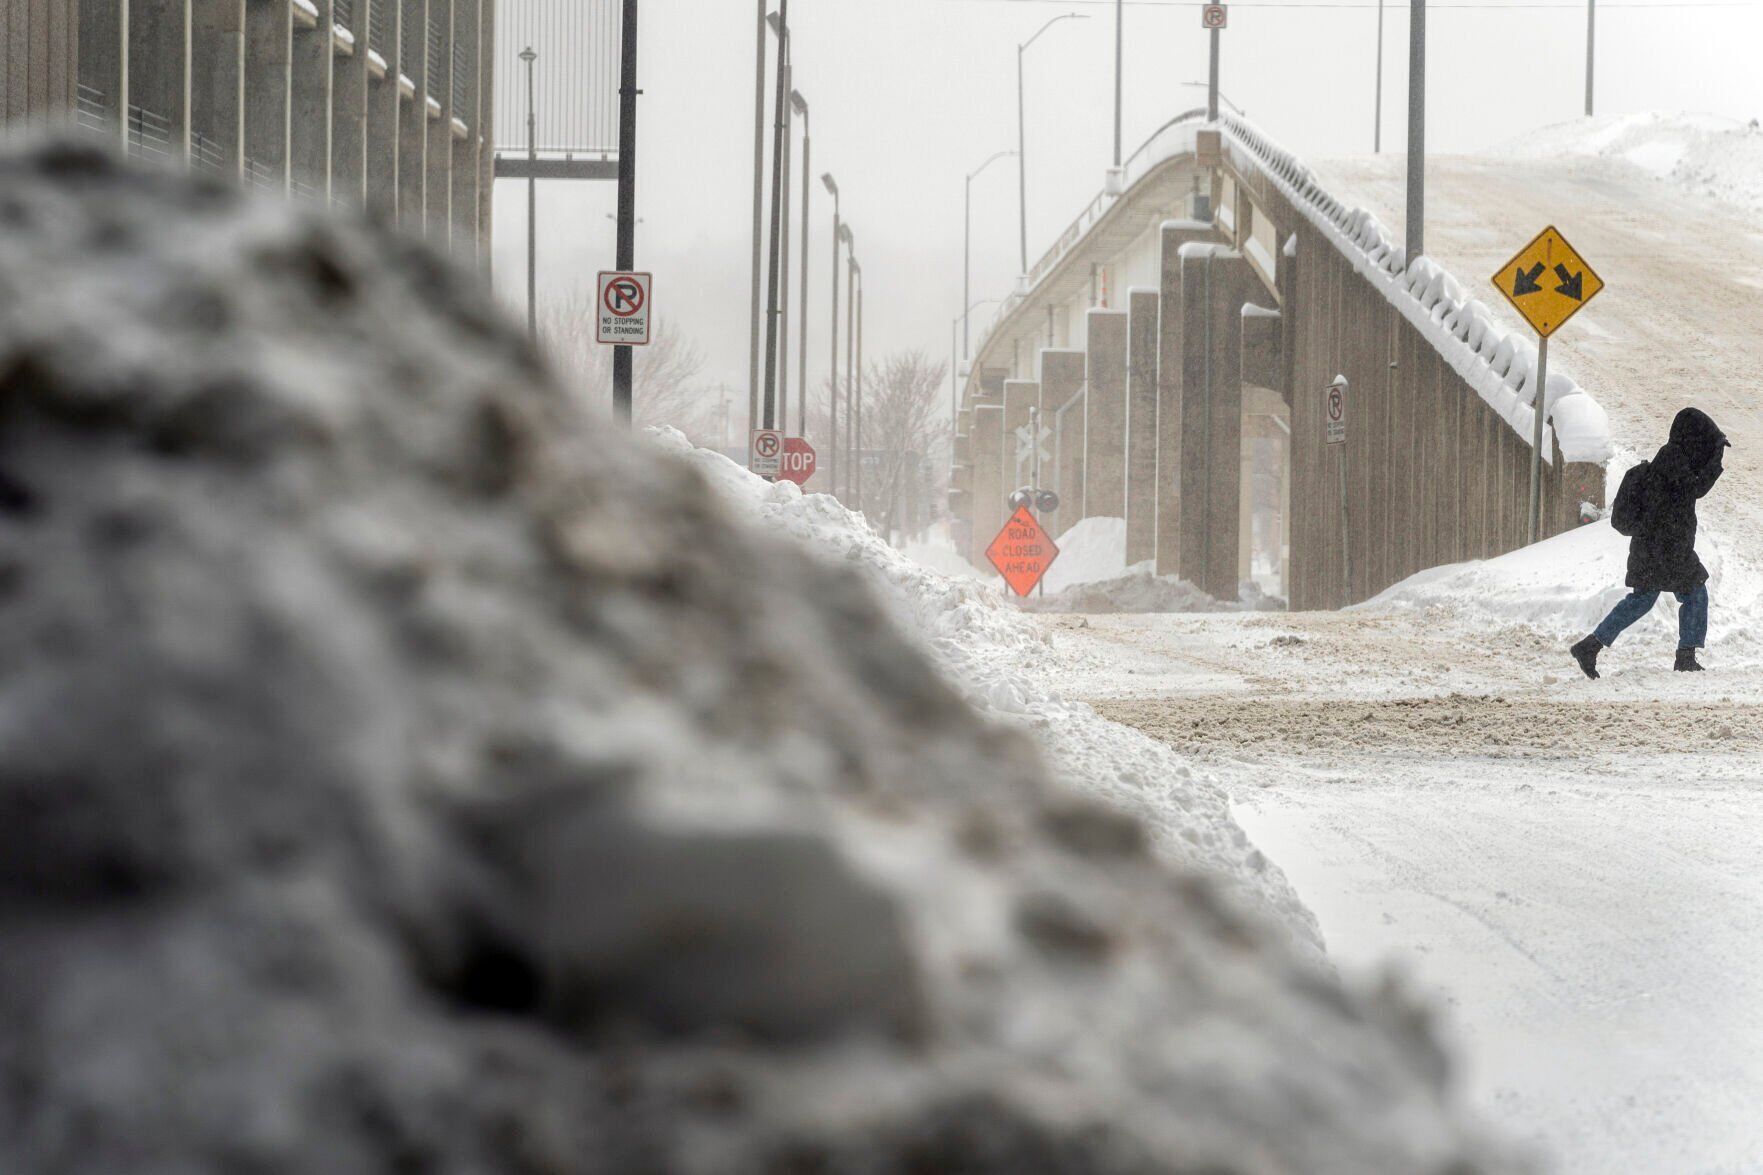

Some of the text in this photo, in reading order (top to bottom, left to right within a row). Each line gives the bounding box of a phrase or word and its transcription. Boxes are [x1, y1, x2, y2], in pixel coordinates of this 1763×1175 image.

[615, 284, 637, 309] P
[602, 317, 644, 326] NO STOPPING
[602, 326, 644, 335] OR STANDING
[782, 452, 814, 471] TOP
[1008, 528, 1036, 540] ROAD
[1002, 545, 1042, 557] CLOSED
[1005, 561, 1040, 573] AHEAD
